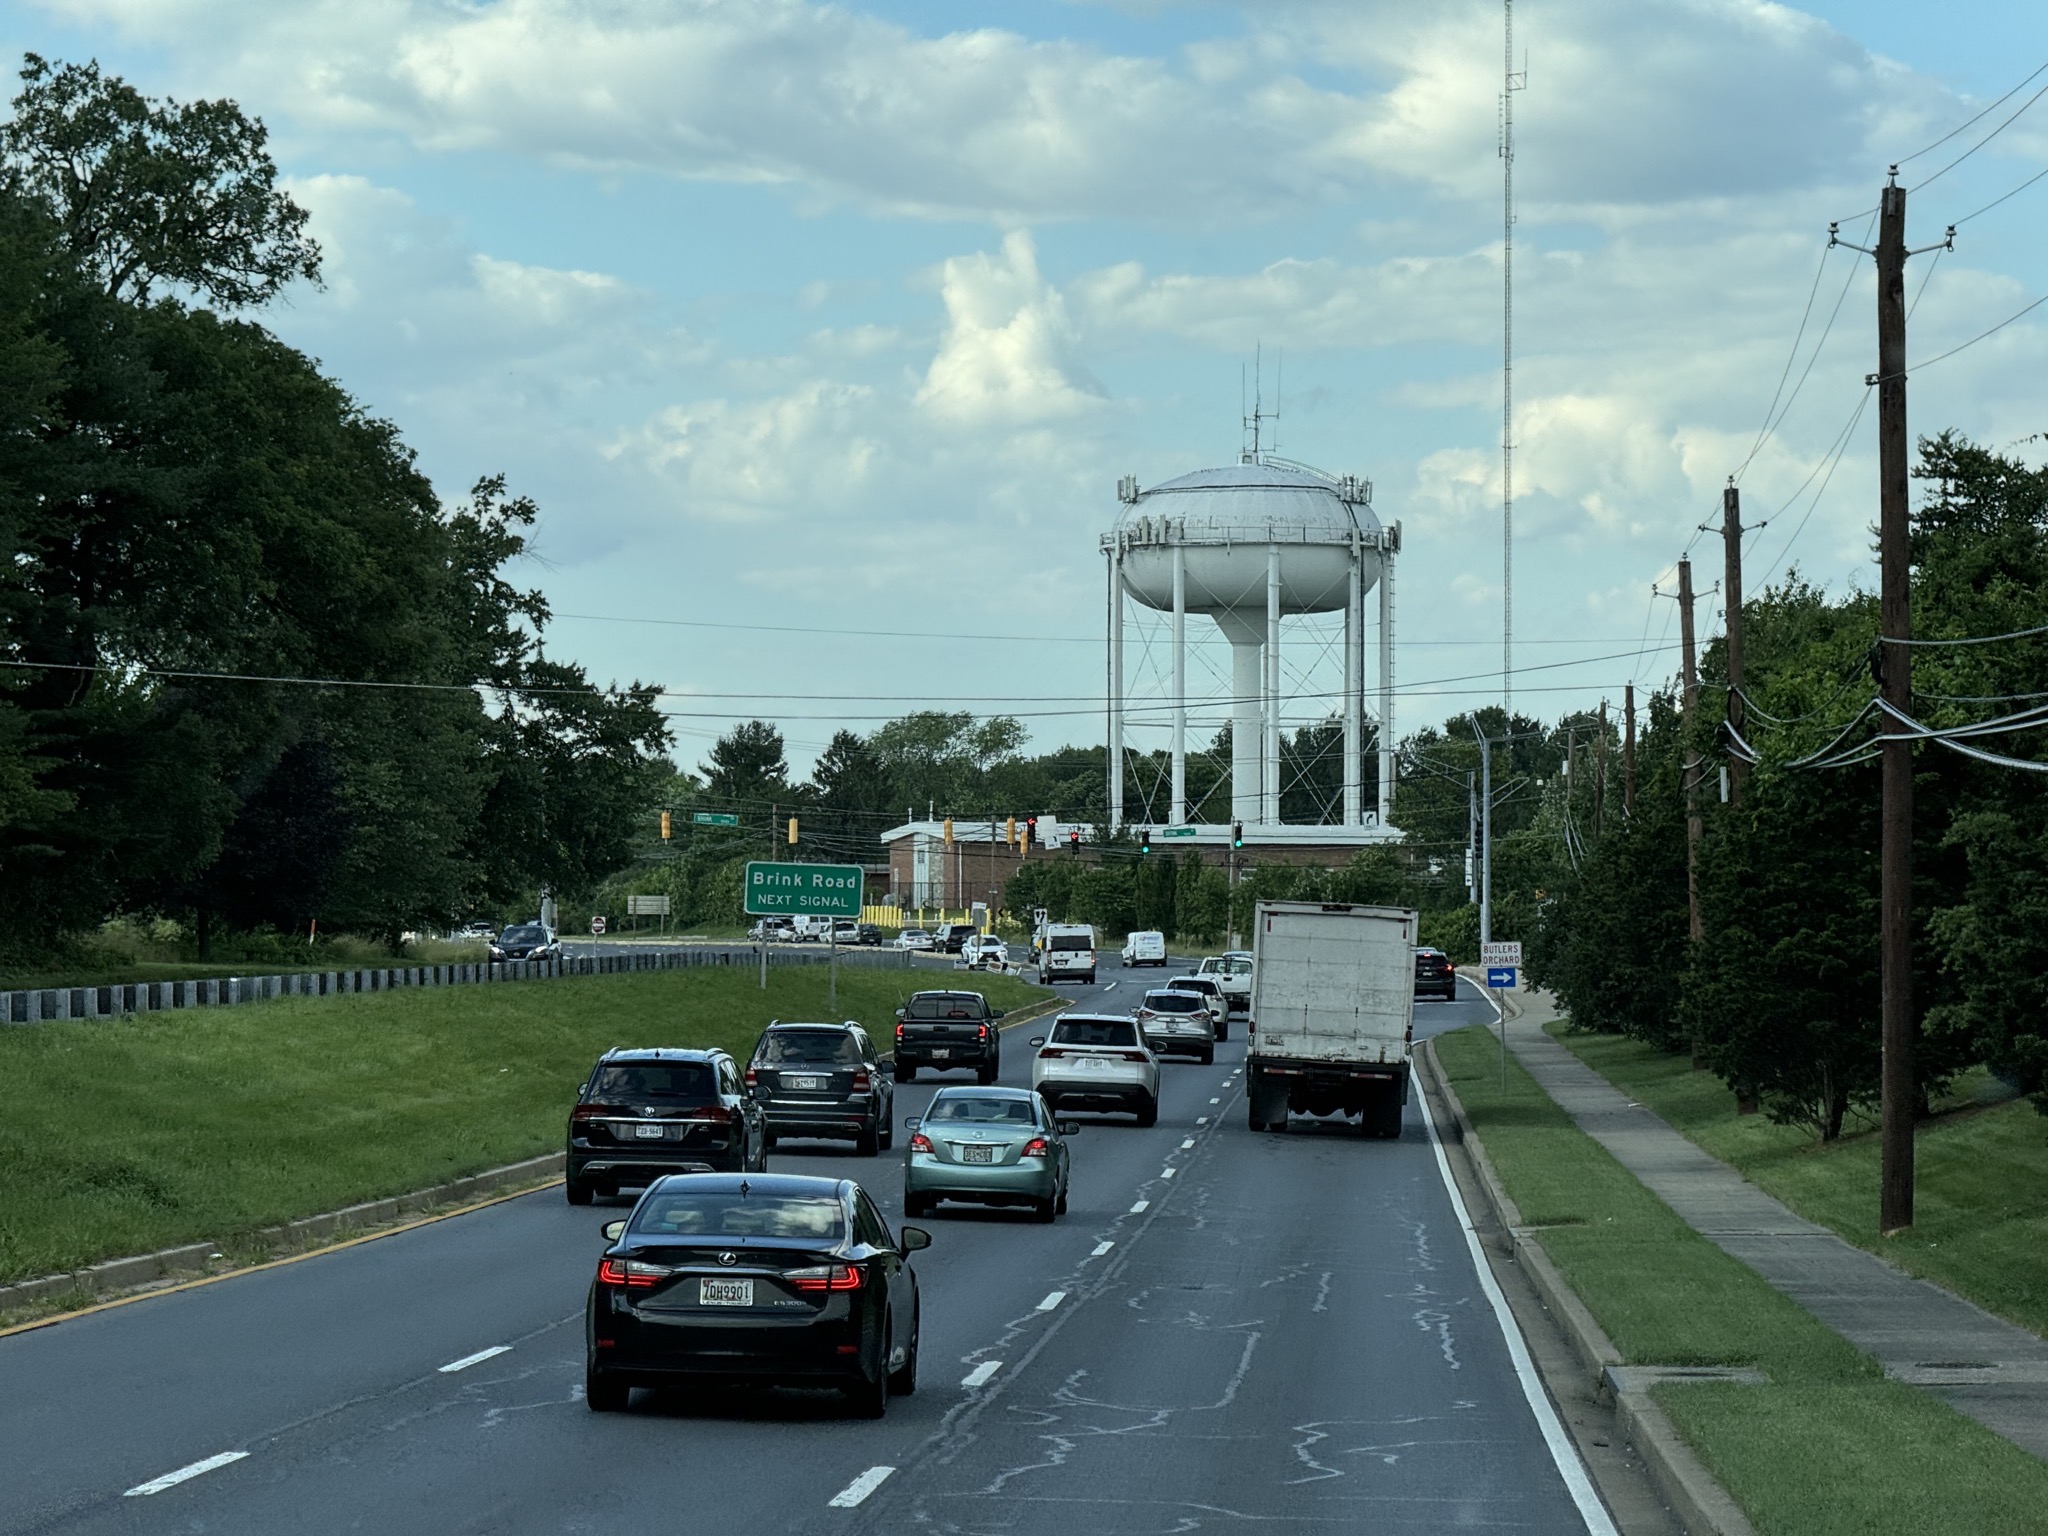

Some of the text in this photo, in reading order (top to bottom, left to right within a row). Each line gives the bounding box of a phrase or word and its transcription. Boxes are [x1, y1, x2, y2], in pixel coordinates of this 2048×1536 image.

[753, 872, 856, 889] Brink Road
[757, 894, 849, 908] NEXT SIGNAL
[1483, 945, 1519, 954] BUTLERS
[1483, 956, 1520, 965] ORCHARD
